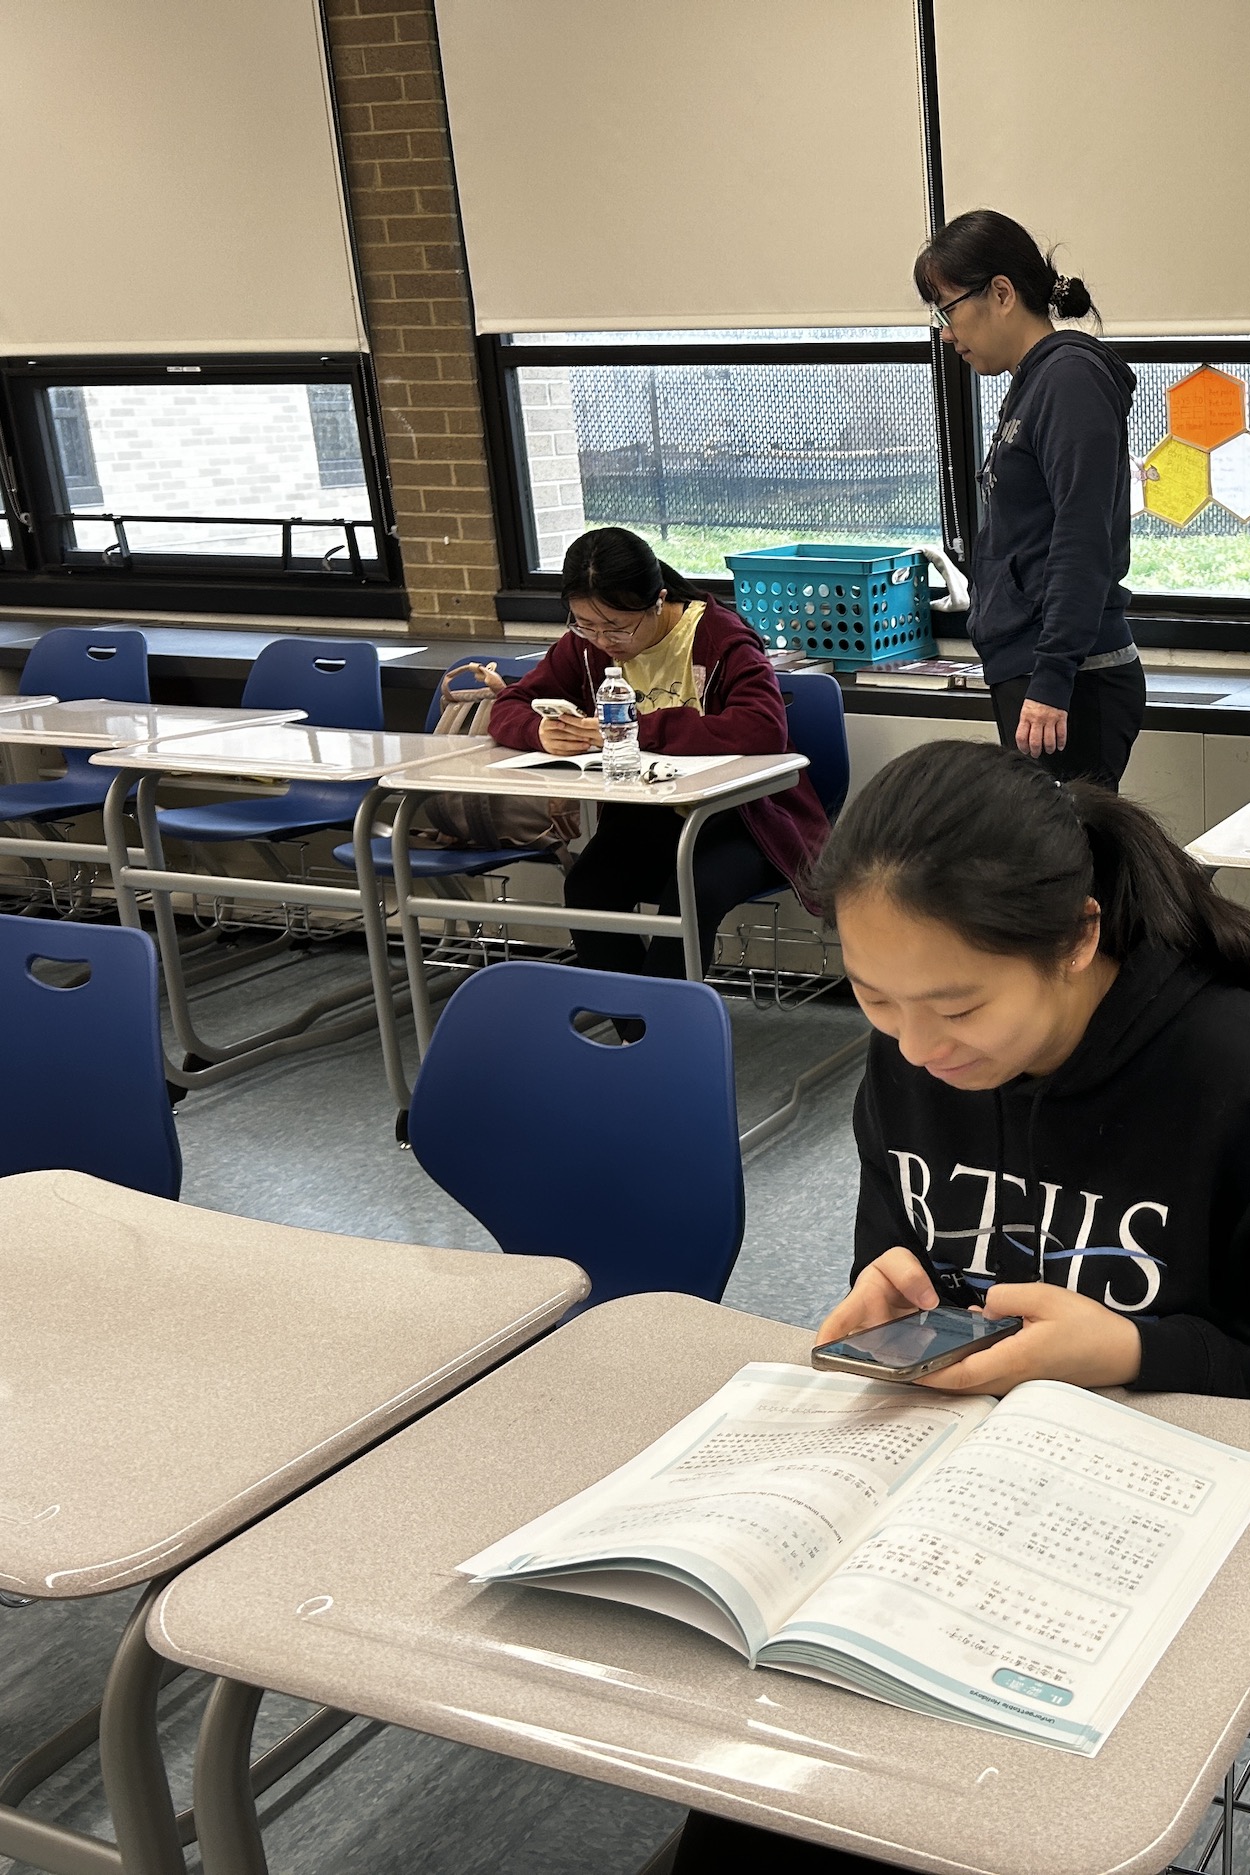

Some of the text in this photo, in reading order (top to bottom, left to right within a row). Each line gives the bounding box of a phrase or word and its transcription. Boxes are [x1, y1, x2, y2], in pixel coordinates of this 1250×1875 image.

[888, 1150, 1168, 1311] BTHS
[969, 1689, 1055, 1724] Unforgettable Holidays
